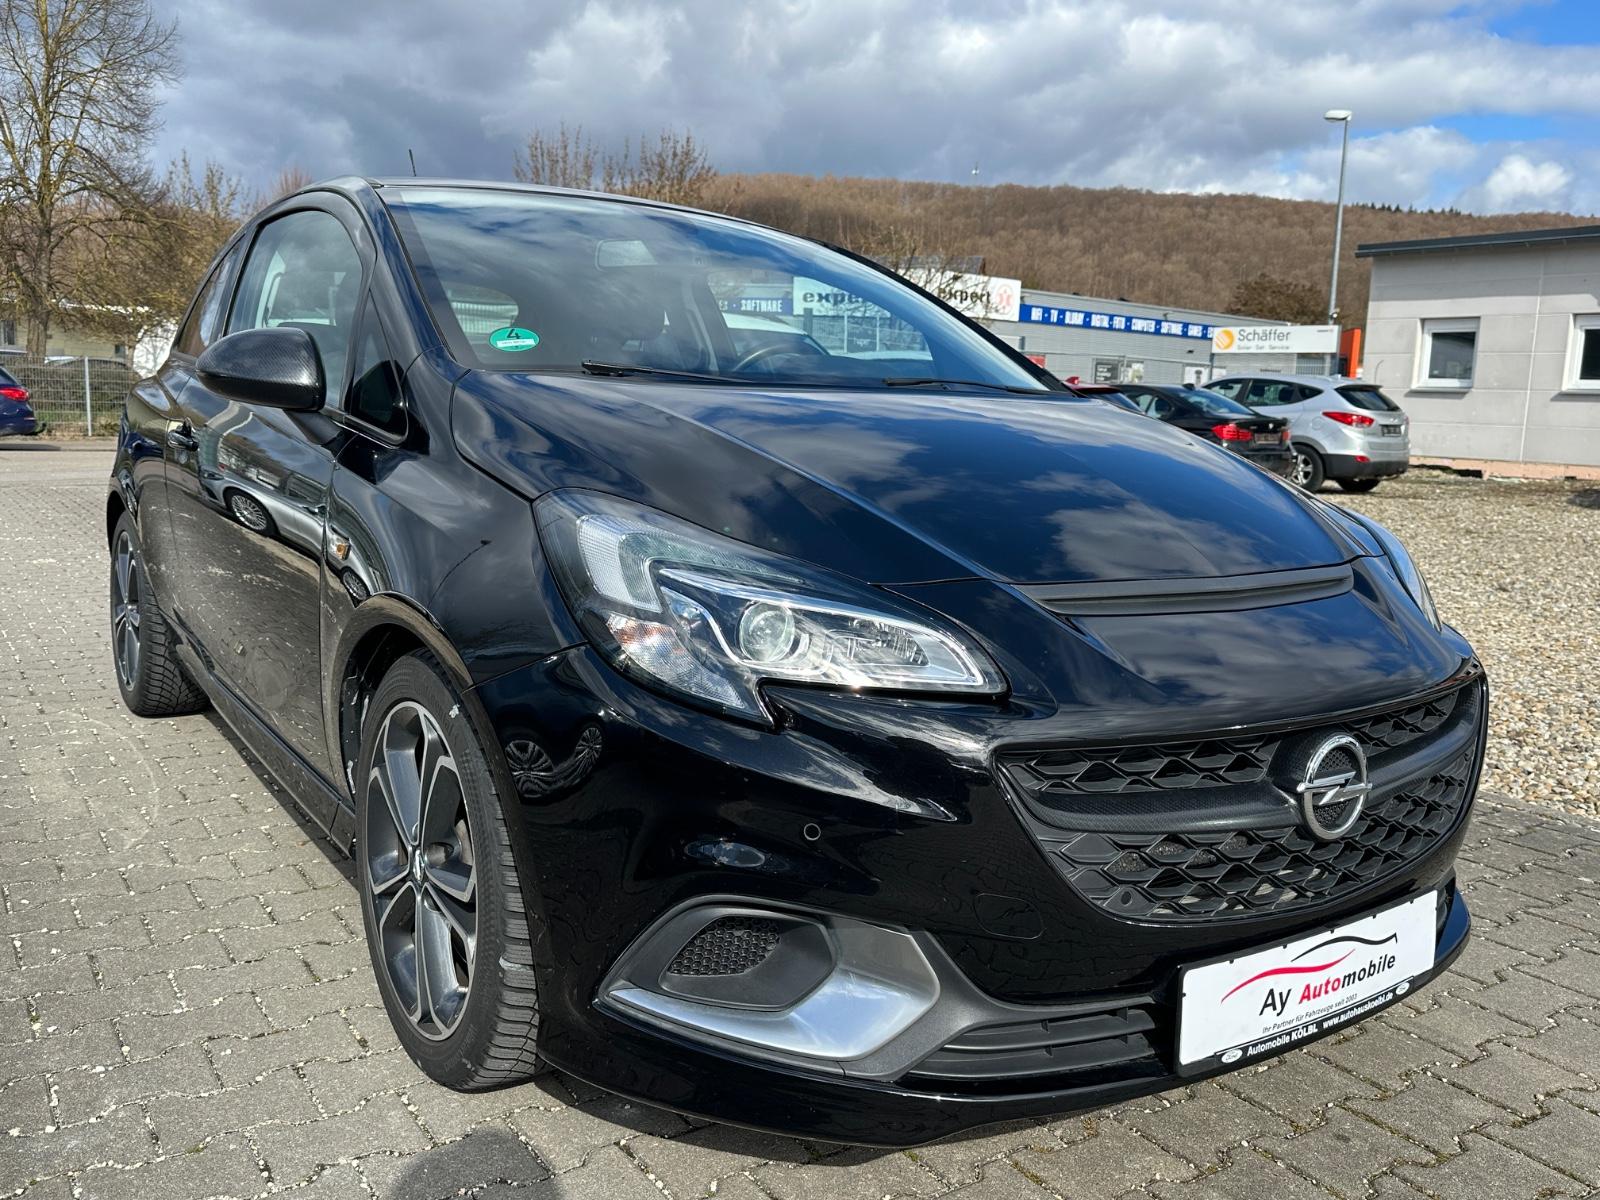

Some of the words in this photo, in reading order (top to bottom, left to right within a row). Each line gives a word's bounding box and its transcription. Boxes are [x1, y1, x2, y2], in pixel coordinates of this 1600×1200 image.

[740, 299, 783, 313] SOFTWARE
[506, 328, 521, 340] 4
[1237, 328, 1291, 342] Schäffer
[1258, 988, 1292, 1017] Ay
[1298, 953, 1397, 1005] Automobile
[1246, 1033, 1291, 1057] Automobile
[1291, 1023, 1318, 1042] KÖLBL
[1322, 992, 1394, 1029] www.autohauskoelbl.de
[1262, 1025, 1272, 1034] Ihr
[1272, 1017, 1295, 1031] Partner
[1295, 1013, 1305, 1024] für
[1304, 1003, 1334, 1019] Fahrzeuge
